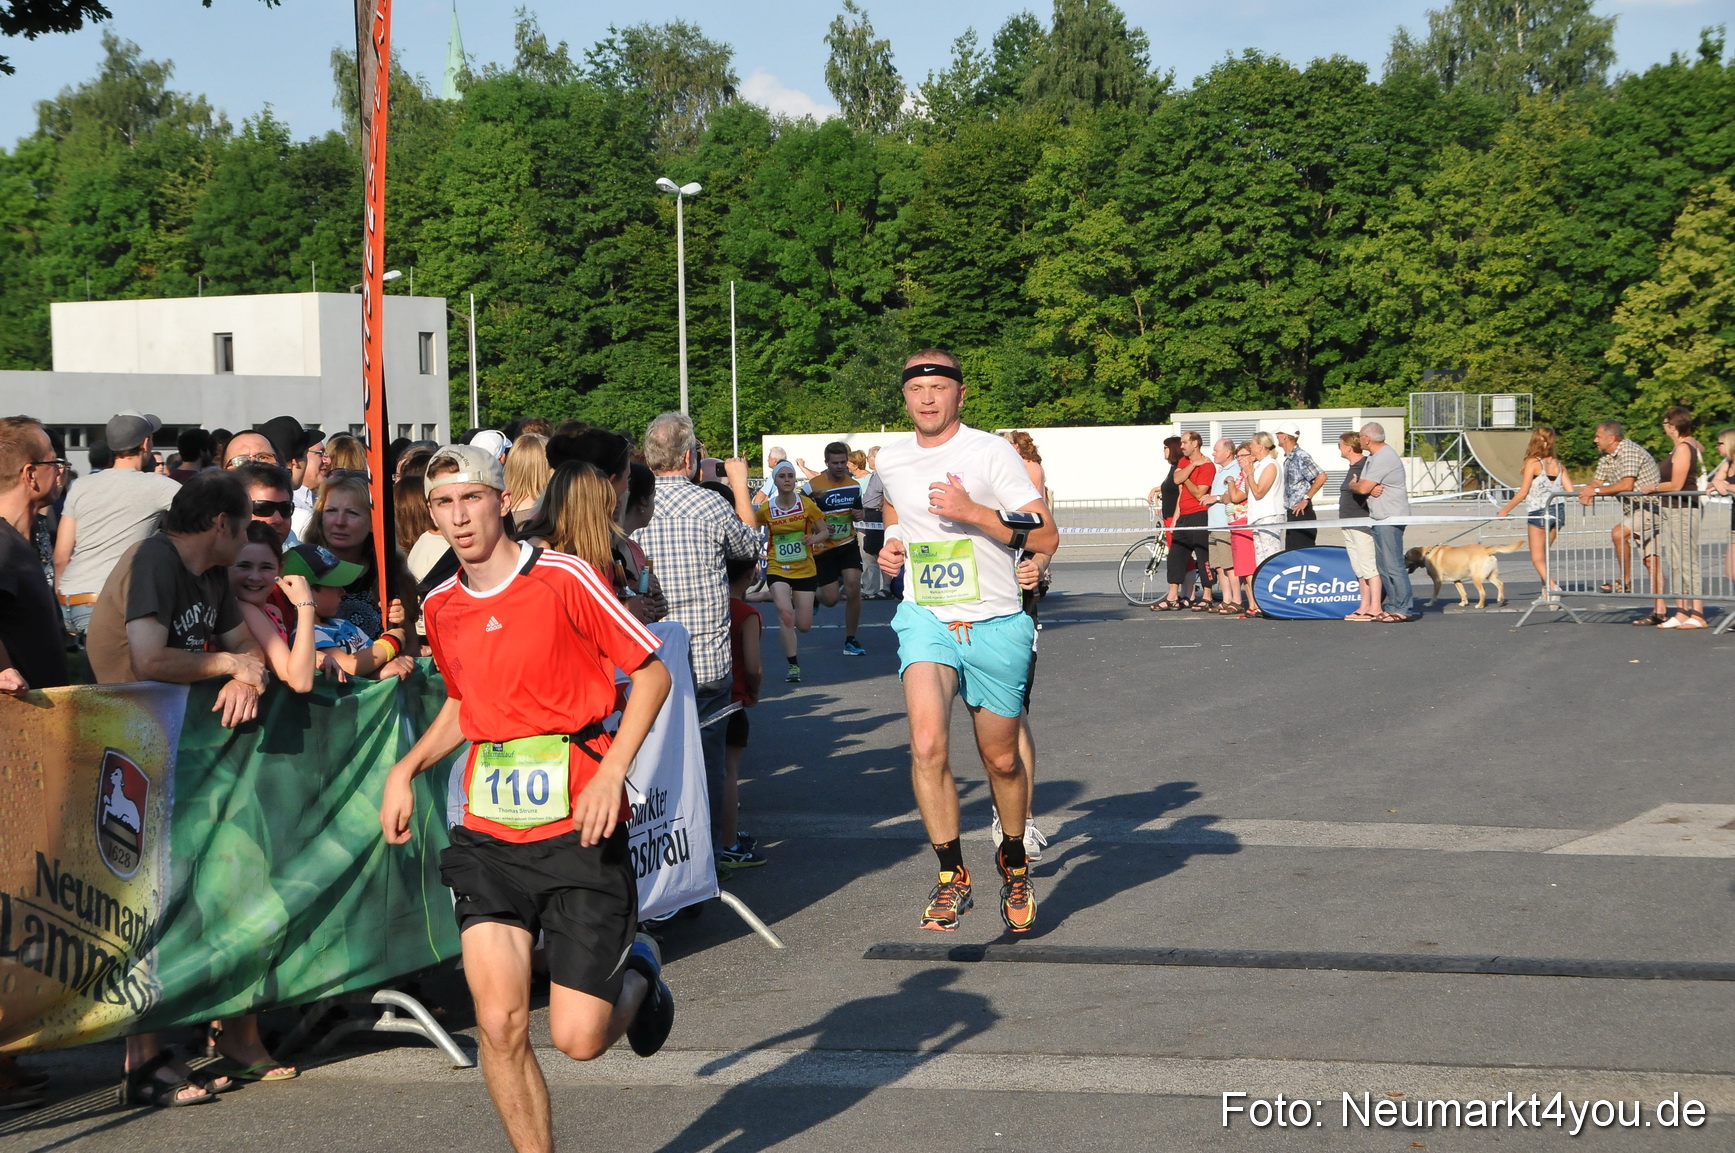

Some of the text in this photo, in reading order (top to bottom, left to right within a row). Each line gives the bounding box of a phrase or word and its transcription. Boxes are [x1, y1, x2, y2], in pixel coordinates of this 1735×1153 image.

[831, 496, 855, 505] Fischer
[779, 542, 802, 556] 808
[919, 562, 965, 589] 429
[1286, 577, 1360, 597] Fische
[485, 623, 503, 633] adidas
[485, 768, 550, 806] 110
[108, 843, 131, 868] 1628
